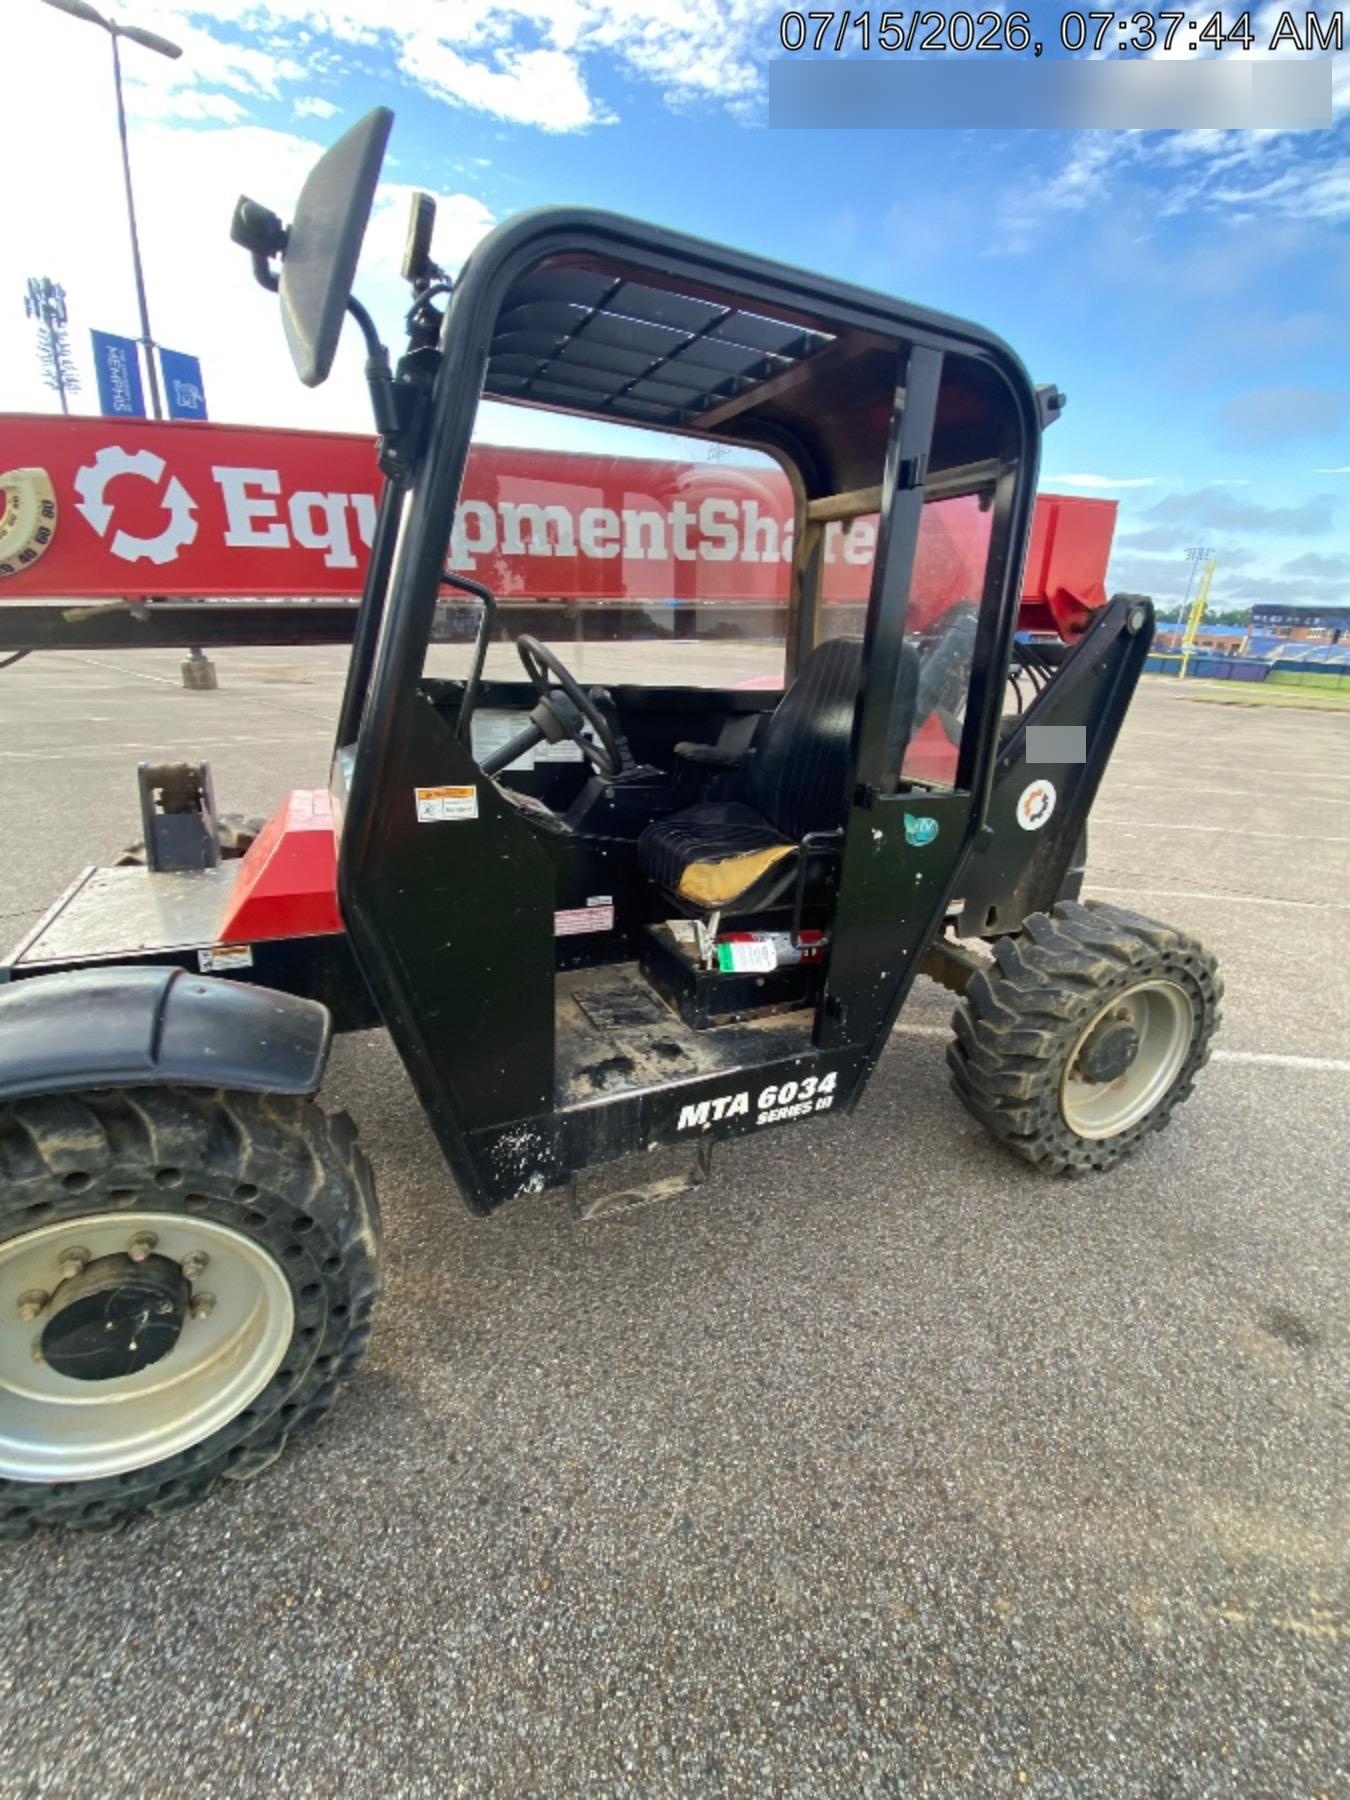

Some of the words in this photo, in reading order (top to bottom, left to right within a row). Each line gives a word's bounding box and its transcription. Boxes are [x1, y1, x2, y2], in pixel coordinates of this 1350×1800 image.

[105, 345, 126, 412] MEMPHIS
[211, 465, 875, 570] EqpmentShre
[676, 1091, 749, 1131] MTA
[757, 1071, 838, 1110] 6034
[756, 1100, 813, 1125] SERIES
